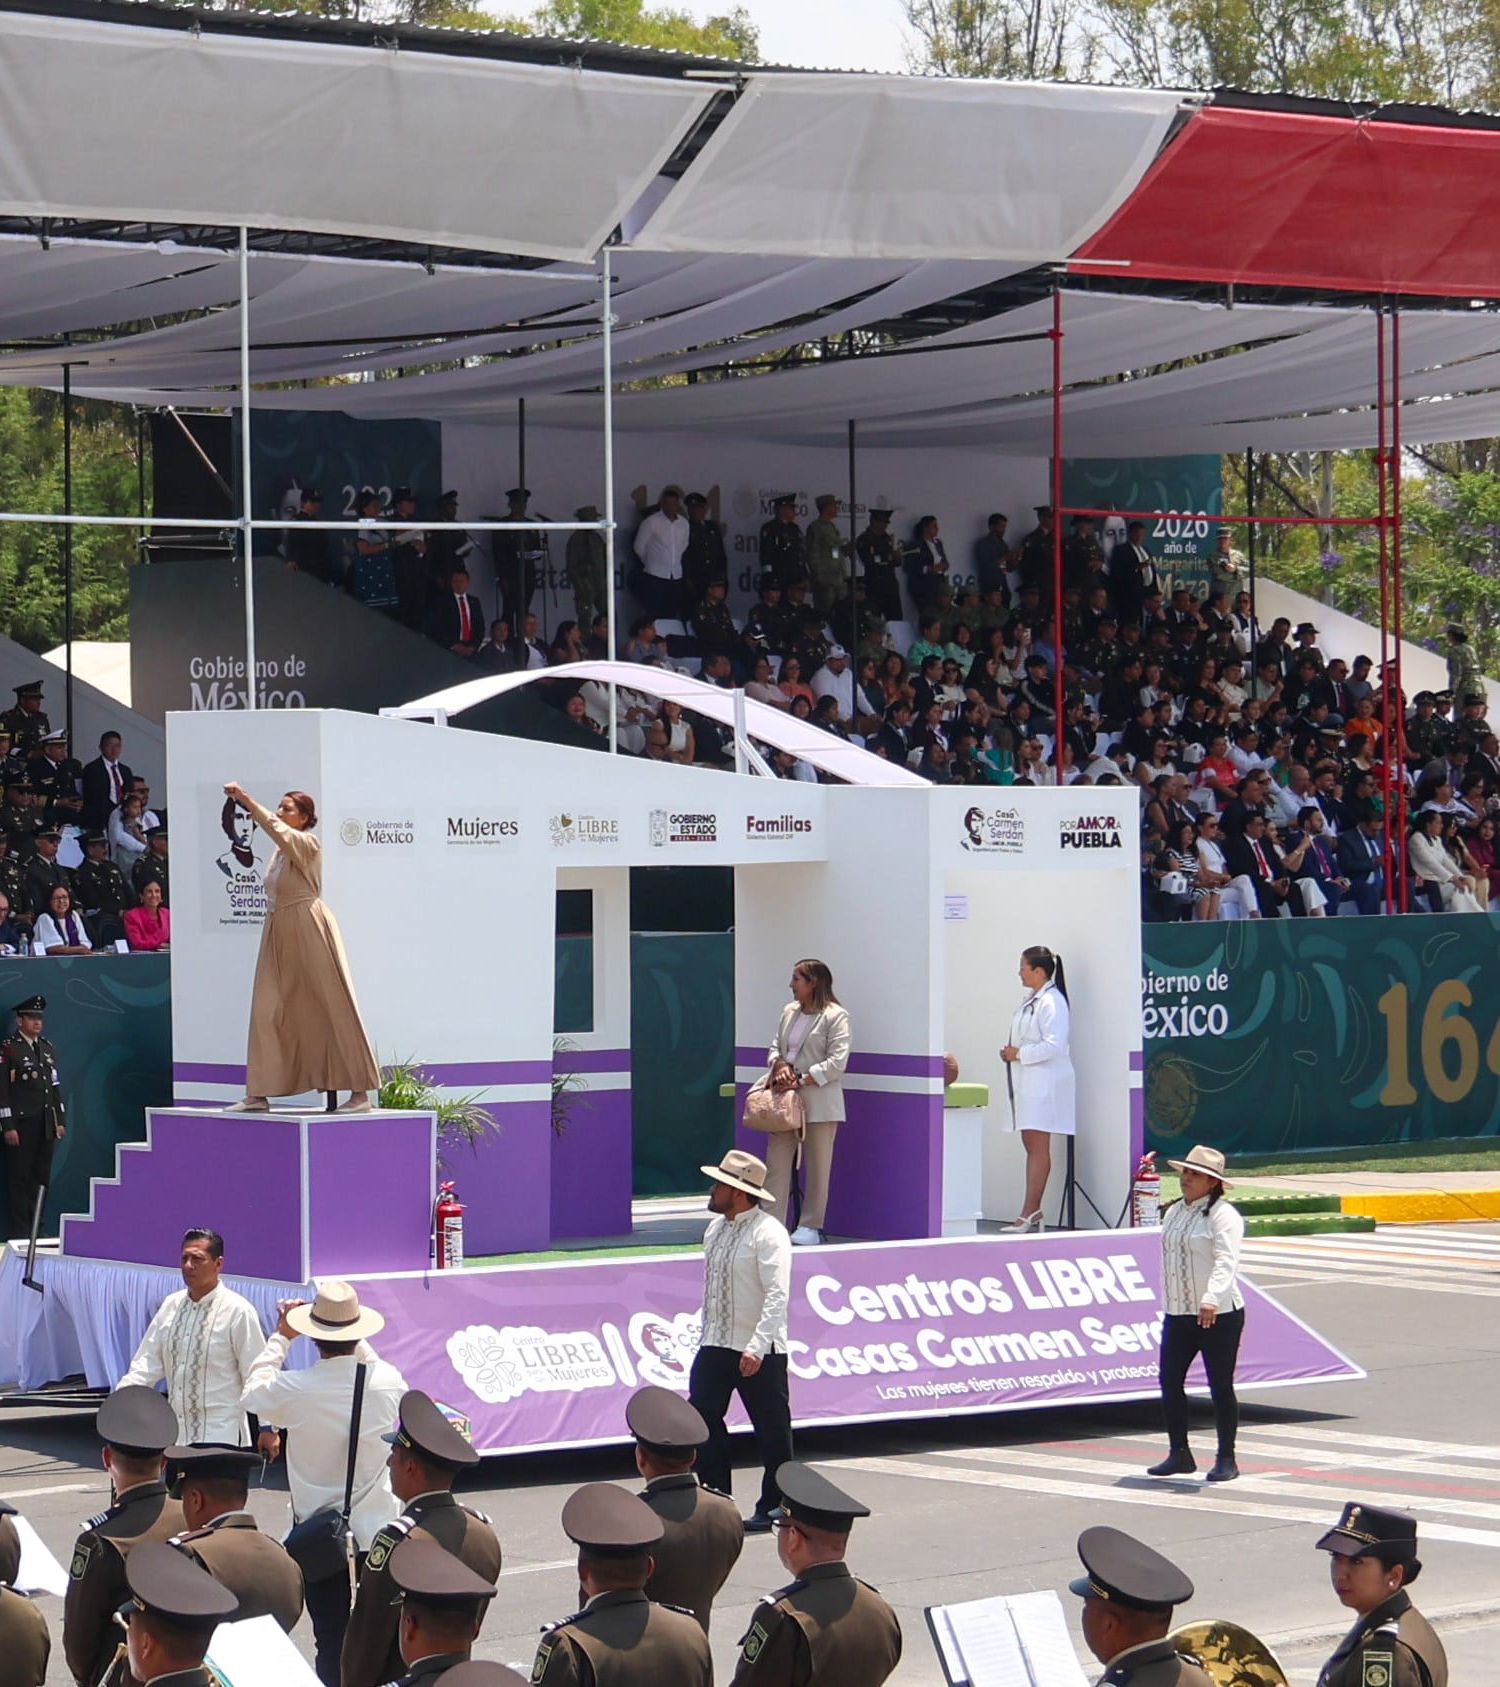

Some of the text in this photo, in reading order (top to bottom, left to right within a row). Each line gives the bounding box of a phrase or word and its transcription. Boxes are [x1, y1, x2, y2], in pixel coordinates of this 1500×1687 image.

[1152, 509, 1209, 538] 2026
[1163, 541, 1197, 554] año de
[190, 654, 306, 679] Gobieno de
[366, 820, 414, 829] Gobierno de
[578, 820, 619, 833] LIBRE
[670, 814, 716, 824] GOBIERNO
[747, 814, 812, 832] Familias
[987, 816, 1024, 828] Carmen
[366, 829, 414, 844] México
[447, 817, 518, 839] Mujeres
[680, 824, 716, 834] ESTADO
[1060, 832, 1122, 849] PUEBLA
[235, 873, 256, 883] Casa
[1141, 967, 1229, 994] ierno de
[1142, 995, 1229, 1039] éxico
[1377, 979, 1500, 1107] 16
[805, 1254, 1157, 1326] Centros LIBRE
[512, 1336, 545, 1346] Centro
[787, 1311, 1165, 1380] Casas Carmen Ser
[517, 1342, 601, 1368] LIBRE
[546, 1365, 609, 1382] Mujeres
[876, 1361, 1160, 1400] Las mujeres tienen respaldo y protecci
